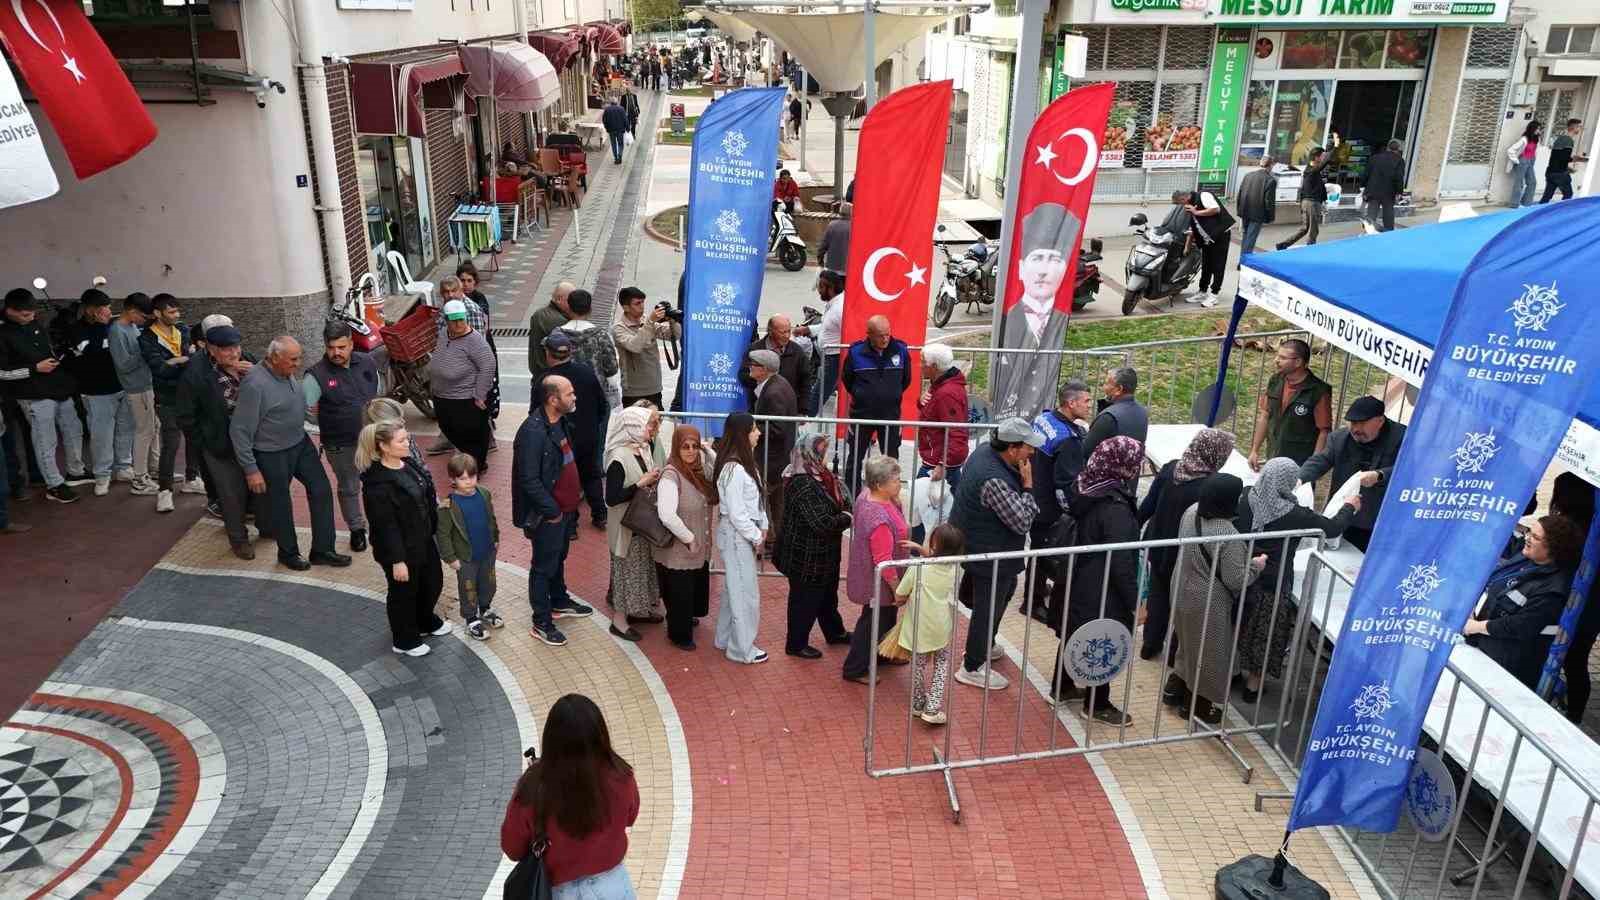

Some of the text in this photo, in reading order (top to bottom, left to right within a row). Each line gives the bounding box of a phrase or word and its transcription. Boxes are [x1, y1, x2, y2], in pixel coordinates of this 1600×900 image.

[1220, 0, 1395, 16] MESUT TARIM
[1219, 47, 1237, 111] MESUT
[0, 101, 27, 119] CAK
[1208, 119, 1227, 181] TARIM
[700, 163, 765, 179] BÜYÜKŞEHİR
[711, 175, 753, 186] BELEDİYESİ
[695, 240, 758, 256] BÜYÜKŞEHİR
[724, 236, 746, 244] AYDIN
[705, 251, 747, 261] BELEDİYESİ
[1286, 296, 1303, 316] T.C.
[1305, 307, 1335, 333] AYDIN
[1488, 333, 1556, 351] T.C. AYDIN
[1452, 345, 1576, 374] BÜYÜKŞEHİR
[1467, 368, 1545, 385] BELEDİYESİ
[1432, 478, 1494, 490] T.C. AYDIN
[1400, 487, 1517, 515] BÜYÜKŞEHİR
[1415, 508, 1487, 523] BELEDİYESİ
[1401, 606, 1442, 620] AYDIN
[1351, 617, 1465, 645] BÜYÜKŞEHİR
[1365, 634, 1436, 652] BELEDİYESİ
[1356, 724, 1396, 739] AYDIN
[1310, 734, 1416, 760] BÜYÜKŞEHİR
[1322, 749, 1392, 766] BELEDİYESİ
